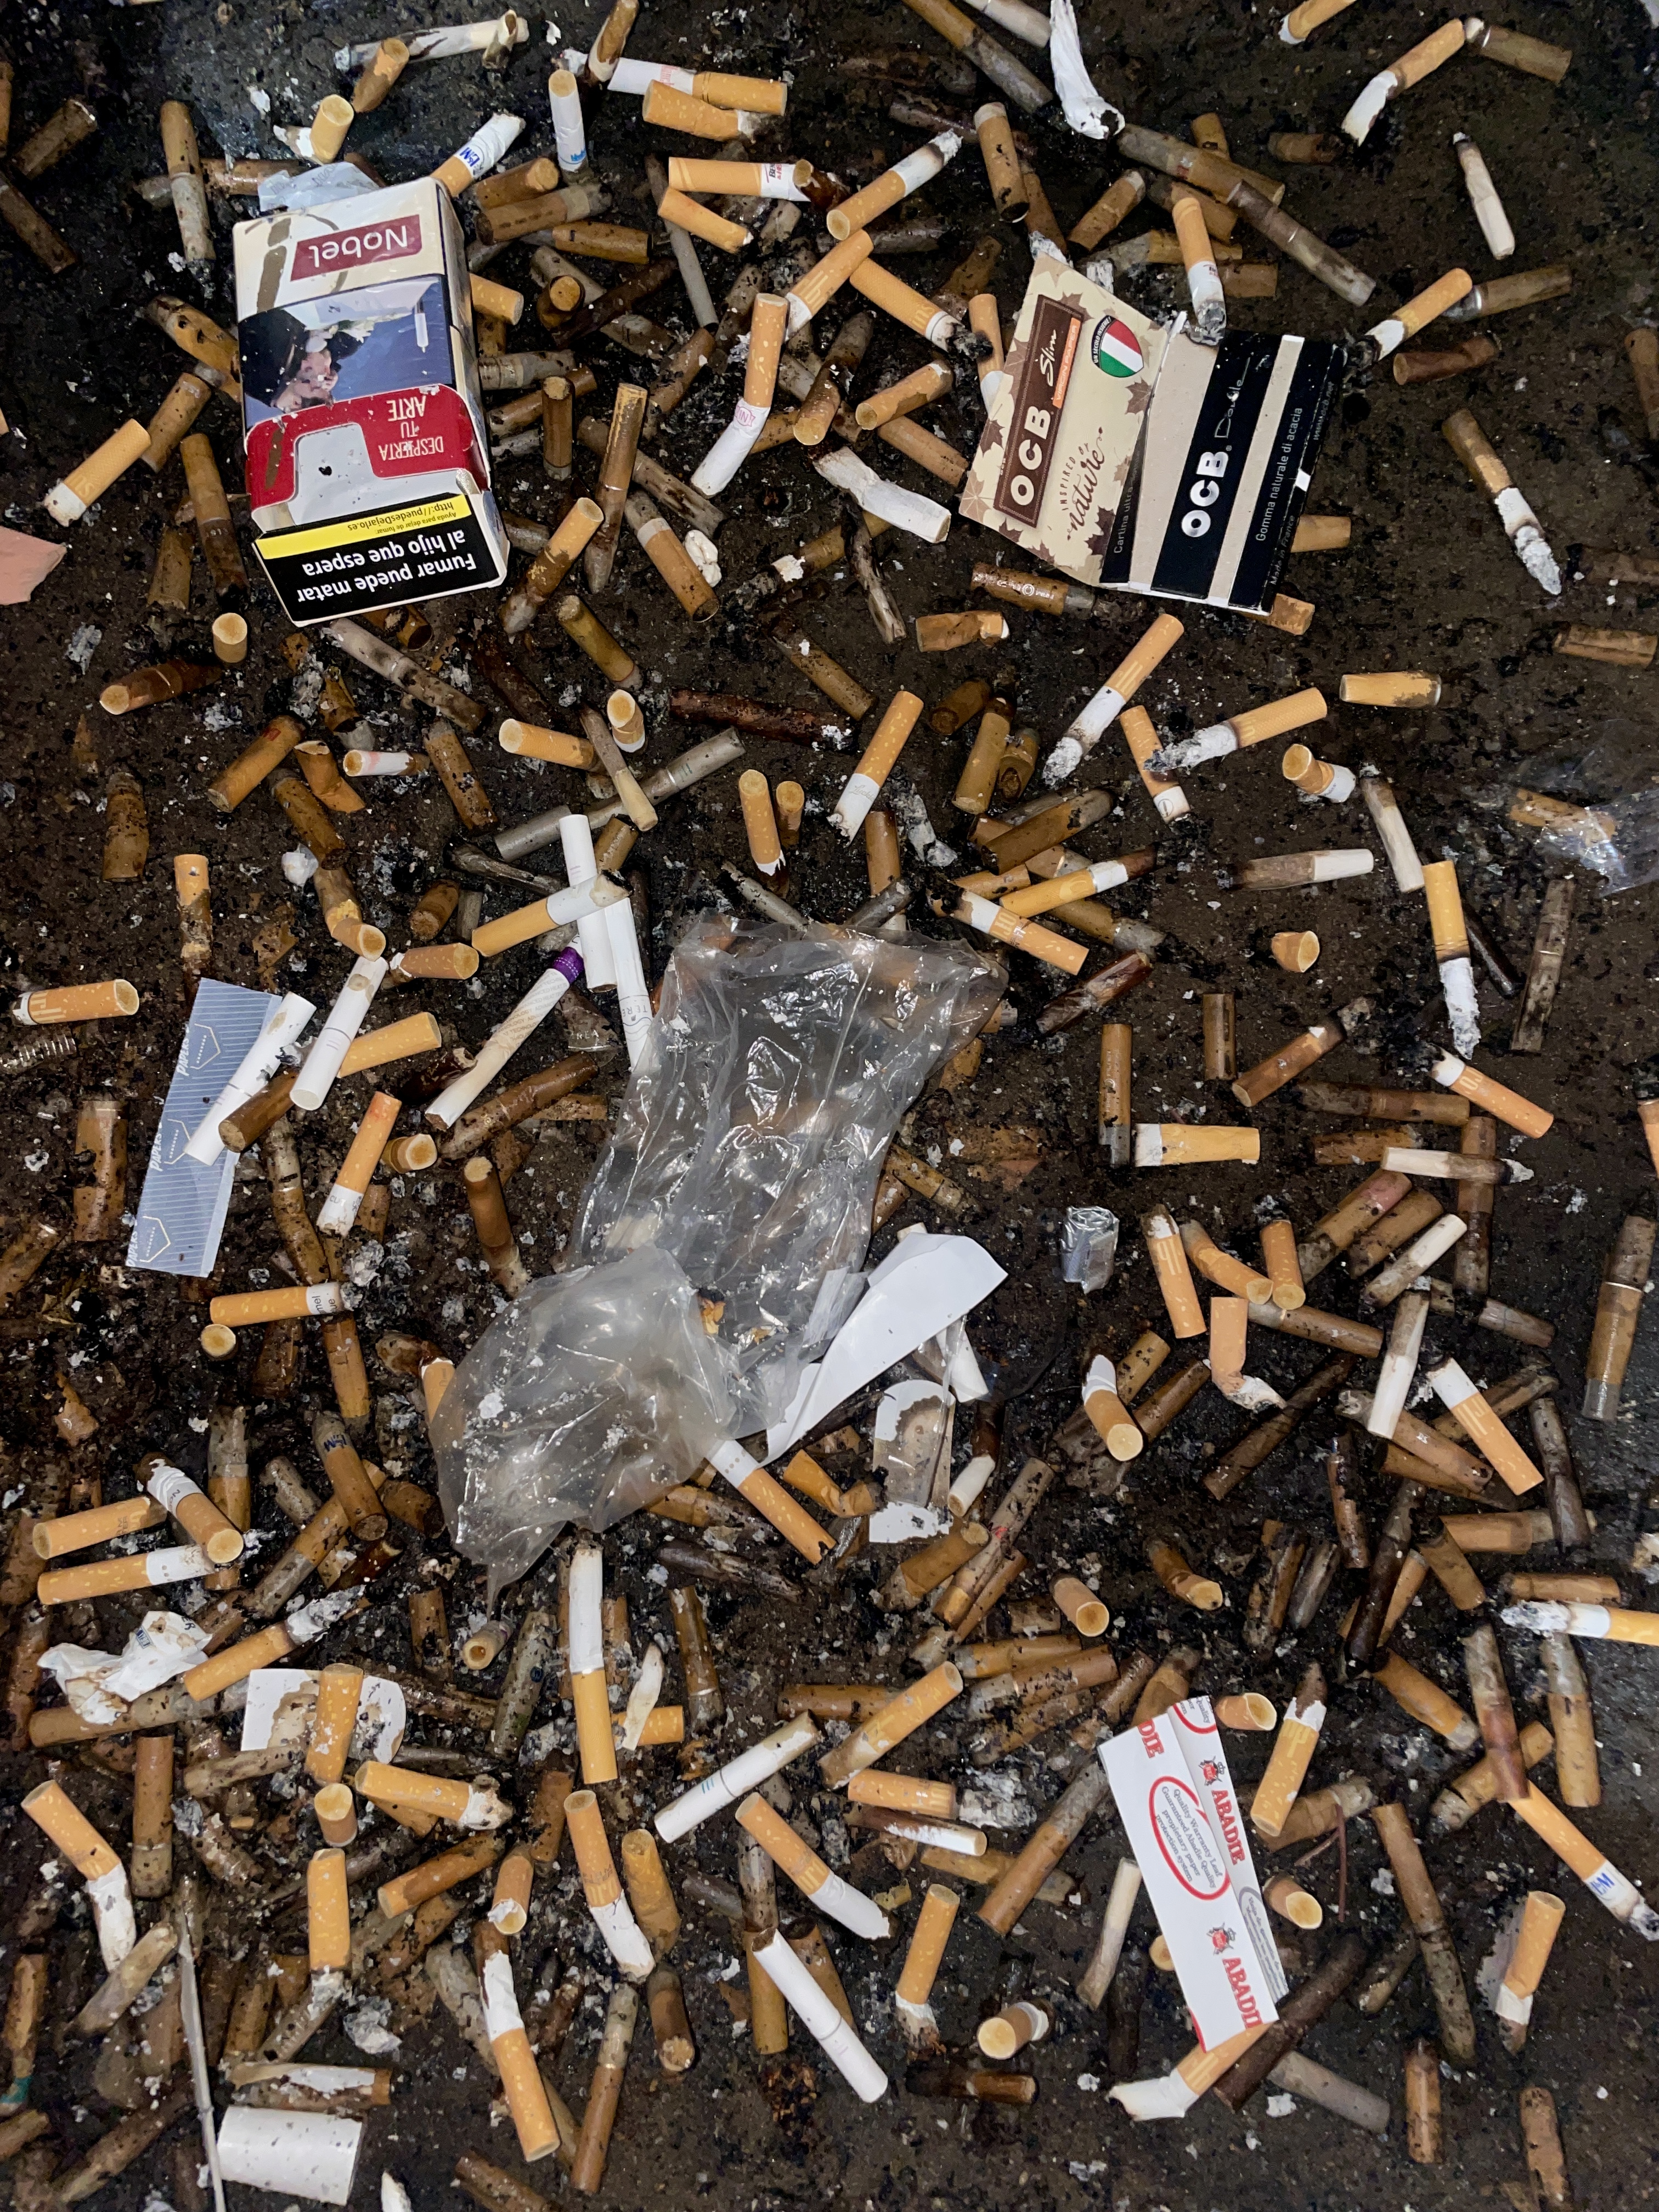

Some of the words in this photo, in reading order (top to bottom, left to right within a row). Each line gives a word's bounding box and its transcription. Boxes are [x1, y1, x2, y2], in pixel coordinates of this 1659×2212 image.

[308, 225, 408, 267] Nobel
[1039, 330, 1057, 386] Slim
[1056, 364, 1069, 402] VIRGIN
[1064, 324, 1077, 364] PAPER
[1093, 355, 1099, 363] UN
[387, 396, 426, 421] ARTE
[400, 421, 415, 438] TU
[379, 436, 444, 461] DESPIERTA
[1011, 406, 1052, 505] OCB
[1060, 457, 1076, 511] INSPIRED
[1079, 443, 1089, 455] BY
[1068, 447, 1105, 531] nature
[1256, 502, 1276, 540] Gomma
[1270, 456, 1288, 498] naturale
[1282, 443, 1292, 453] di
[1287, 408, 1302, 441] acacia
[1181, 452, 1228, 537] OCB
[348, 503, 454, 531] http://puedesDejarlo.es
[437, 512, 456, 521] Ayuda
[1283, 515, 1296, 547] France
[408, 535, 446, 555] hijo
[447, 530, 465, 550] al
[1114, 516, 1129, 553] Cartina
[302, 553, 365, 575] espera
[368, 541, 404, 562] que
[417, 554, 476, 577] Fumar
[1277, 548, 1286, 558] in
[354, 563, 413, 592] puede
[1271, 558, 1284, 585] Made
[297, 581, 352, 602] matar
[618, 1003, 650, 1015] TERE
[177, 1037, 190, 1076] PAPERS
[150, 1132, 163, 1172] PAPERS
[312, 1296, 324, 1314] mel
[1162, 1786, 1189, 1836] Guaranteed
[1186, 1834, 1202, 1860] Abadie
[1201, 1860, 1216, 1888] Quality
[1162, 1807, 1188, 1853] propietary
[1185, 1853, 1200, 1876] paper
[1174, 1787, 1192, 1818] Quality
[1190, 1818, 1211, 1857] Warranty
[1210, 1858, 1223, 1877] Leaf
[1212, 1791, 1245, 1864] ABADIE
[1154, 1812, 1178, 1855] protection
[1177, 1855, 1192, 1884] system
